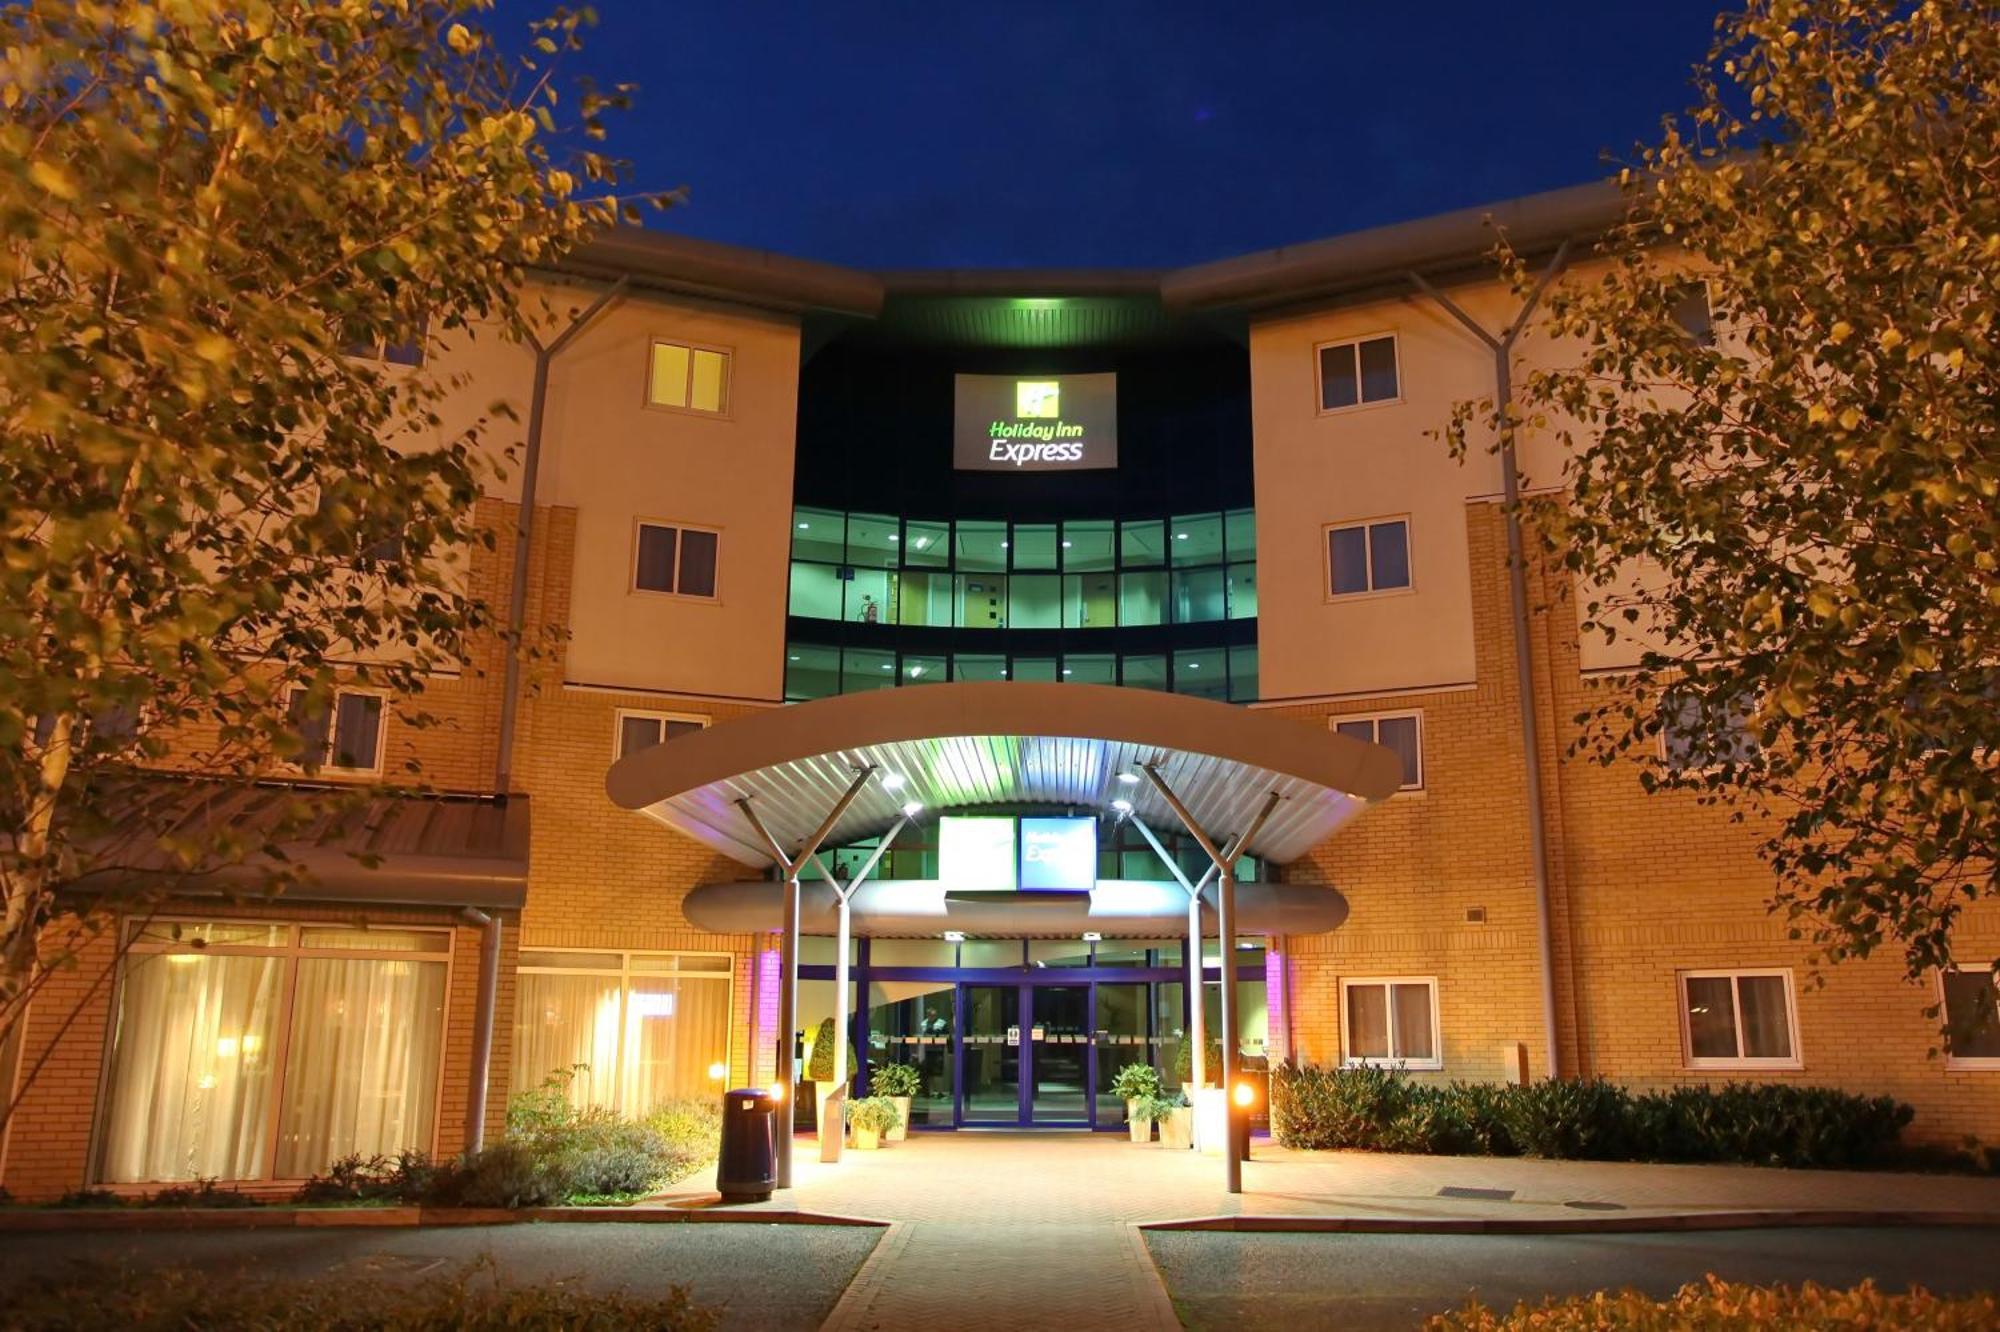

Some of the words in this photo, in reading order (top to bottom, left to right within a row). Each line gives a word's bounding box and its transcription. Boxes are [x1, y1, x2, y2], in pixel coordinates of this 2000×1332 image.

[989, 421, 1055, 441] Holiday
[1056, 421, 1084, 438] Inn
[989, 439, 1084, 467] Express
